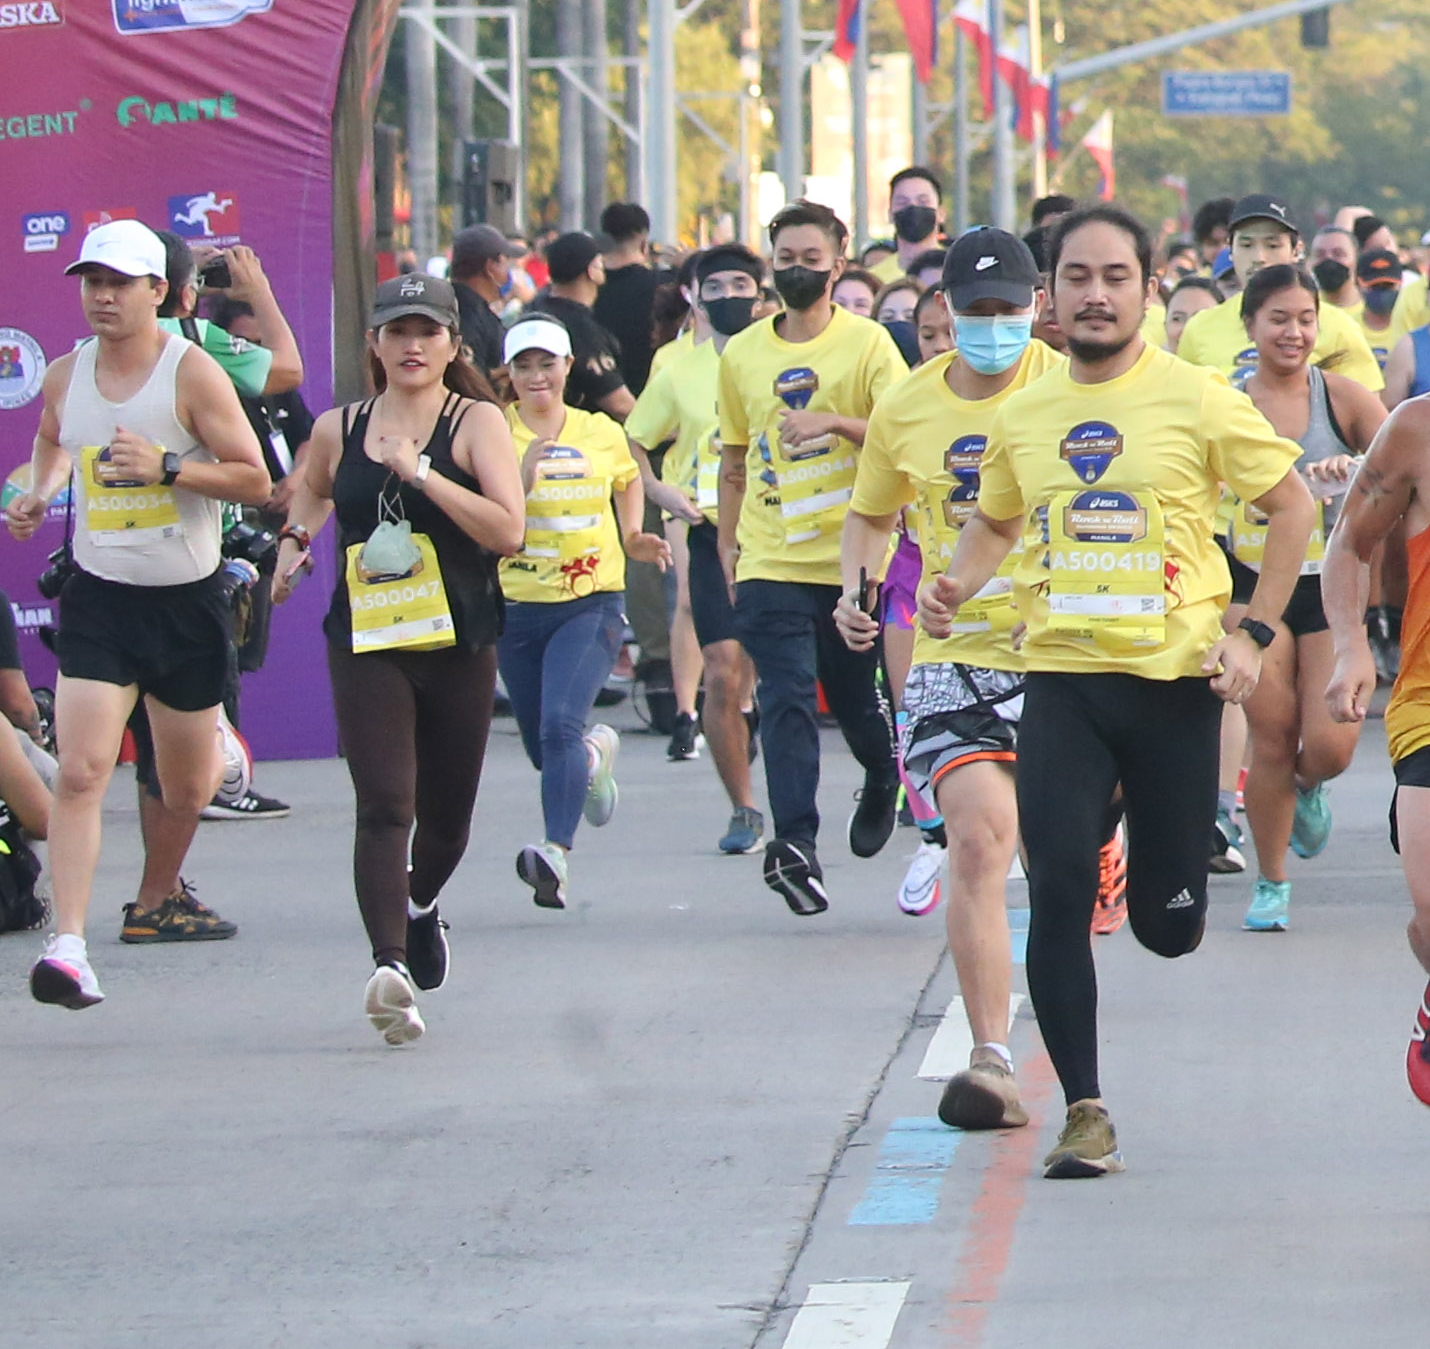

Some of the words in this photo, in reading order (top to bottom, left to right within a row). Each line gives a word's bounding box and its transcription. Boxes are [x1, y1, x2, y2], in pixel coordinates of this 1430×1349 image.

[27, 215, 66, 233] one
[1051, 550, 1161, 571] A500419
[350, 579, 441, 613] A500047
[1096, 584, 1111, 594] 5K
